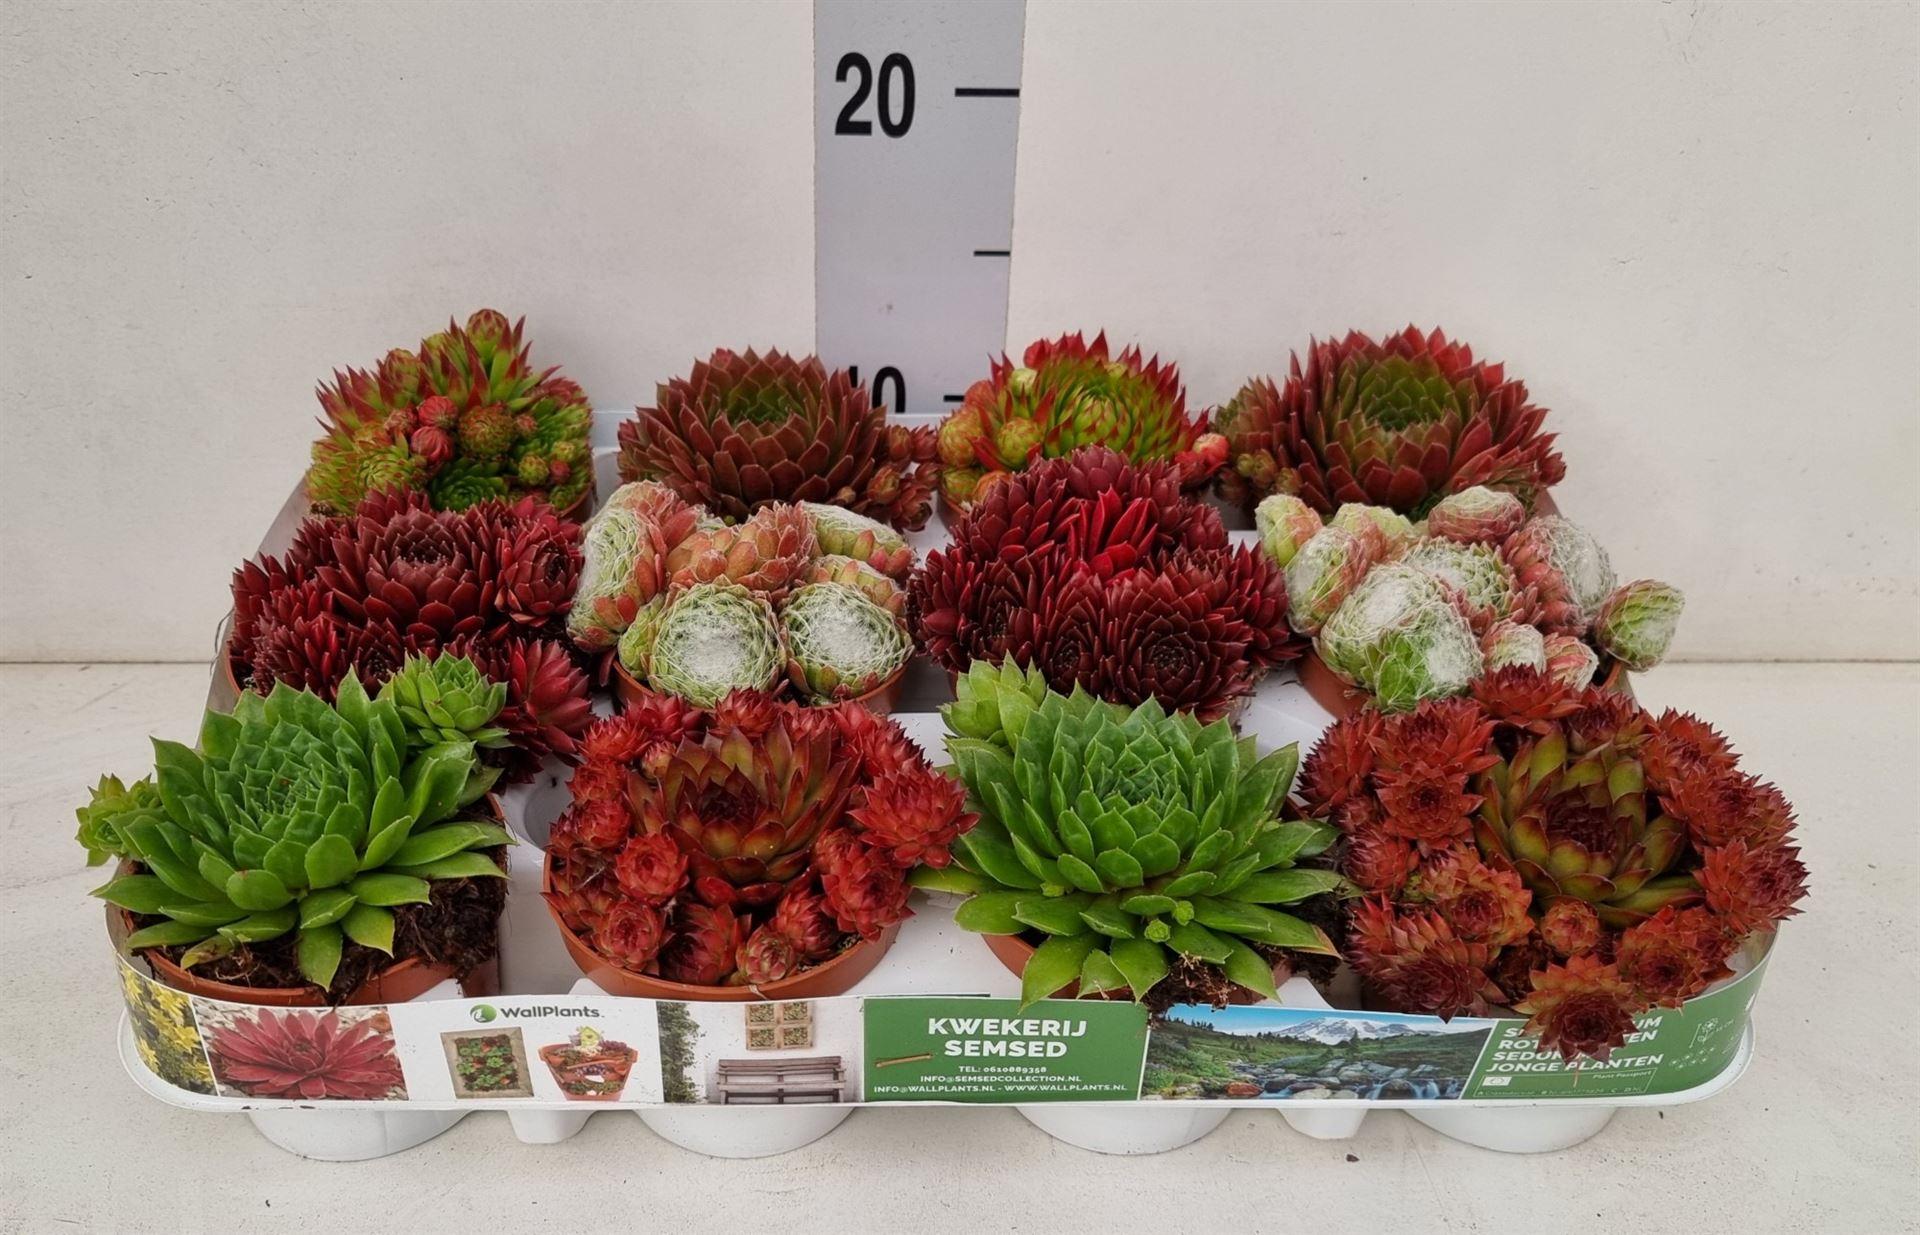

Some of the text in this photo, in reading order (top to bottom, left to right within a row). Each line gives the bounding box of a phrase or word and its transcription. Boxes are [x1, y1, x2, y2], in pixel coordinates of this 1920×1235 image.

[835, 52, 915, 138] 20
[848, 366, 906, 414] 0
[501, 1006, 600, 1018] WallPlants
[928, 1018, 1087, 1037] KWEKERIJ
[944, 1040, 1067, 1057] SEMSED
[1486, 1053, 1664, 1072] JONGE PLANTEN
[920, 1075, 1082, 1083] INFO@SEMSEDCOLLECTION.NL
[874, 1085, 996, 1093] INFO@WALLPLANTS.NL
[1004, 1084, 1128, 1092] WWW.WALLPLANTS.NL
